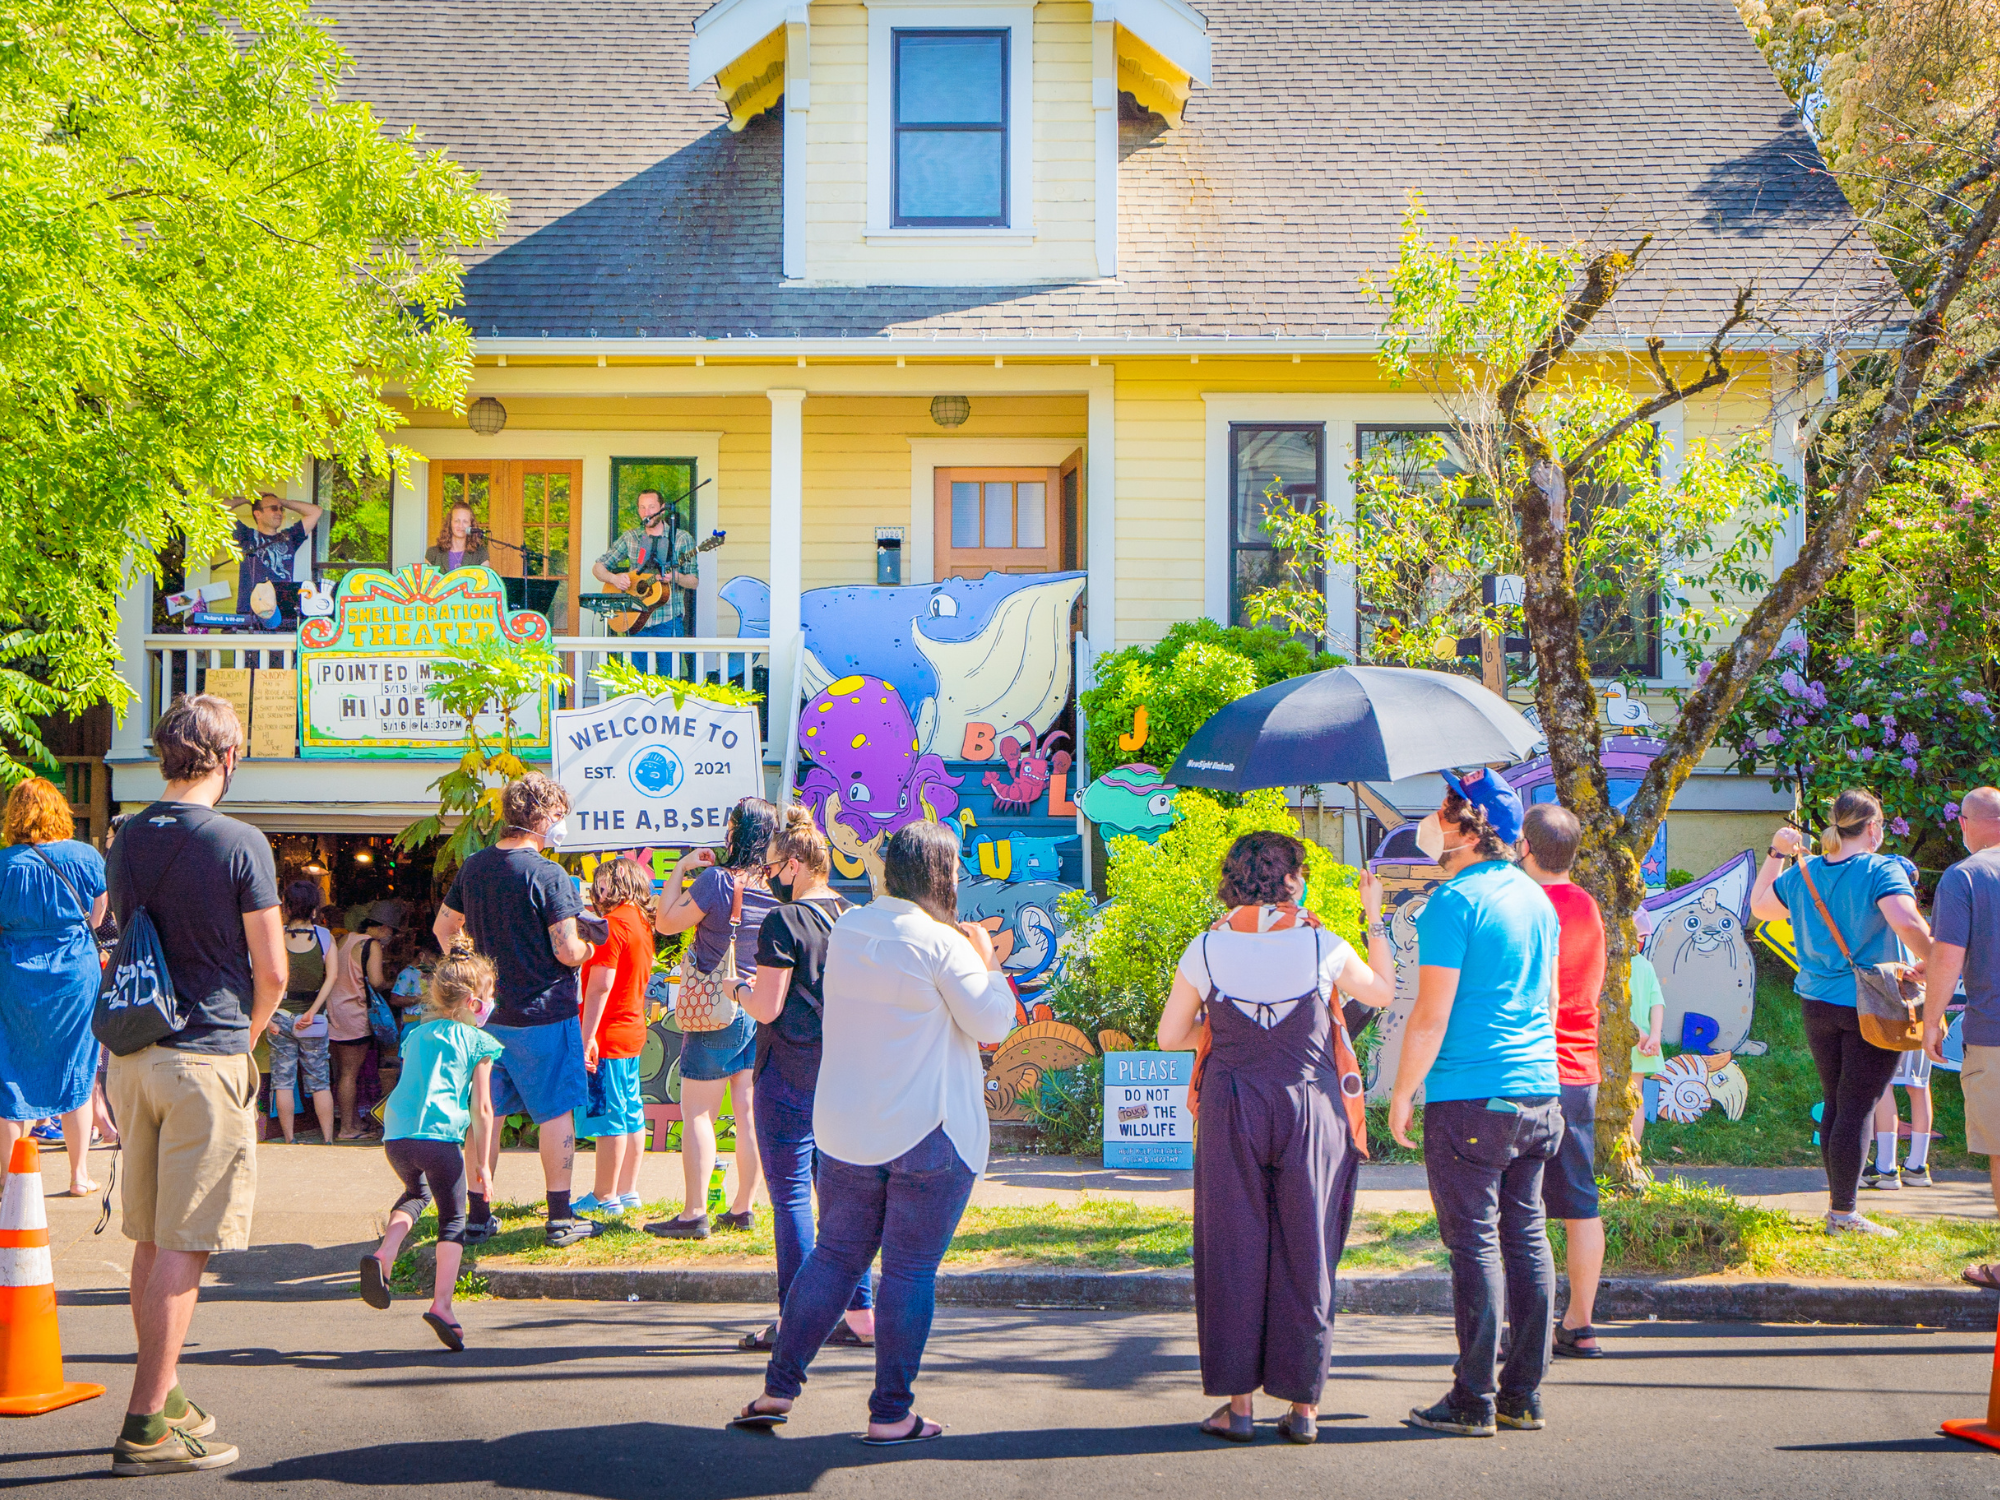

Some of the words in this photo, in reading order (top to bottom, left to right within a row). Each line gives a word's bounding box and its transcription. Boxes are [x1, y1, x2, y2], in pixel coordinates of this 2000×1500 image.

[348, 603, 494, 623] SHELLEBRATION
[348, 621, 497, 647] THEATER
[321, 663, 408, 683] POINTED
[384, 685, 408, 694] 5/15
[342, 698, 366, 717] HI
[379, 697, 426, 717] JOE
[383, 721, 407, 731] 5/16
[423, 719, 462, 730] 4:30PM
[568, 715, 697, 751] WELCOME
[708, 722, 739, 749] TO
[961, 722, 996, 761] B
[584, 766, 616, 779] EST.
[694, 761, 731, 775] 2021
[576, 810, 625, 831] THE
[978, 839, 1012, 881] U
[1118, 1059, 1179, 1081] PLEASE
[1124, 1088, 1142, 1101] DO
[1146, 1088, 1170, 1101] NOT
[1121, 1105, 1148, 1120] TOUCH
[1153, 1105, 1177, 1119] THE
[1119, 1123, 1176, 1137] WILDLIFE
